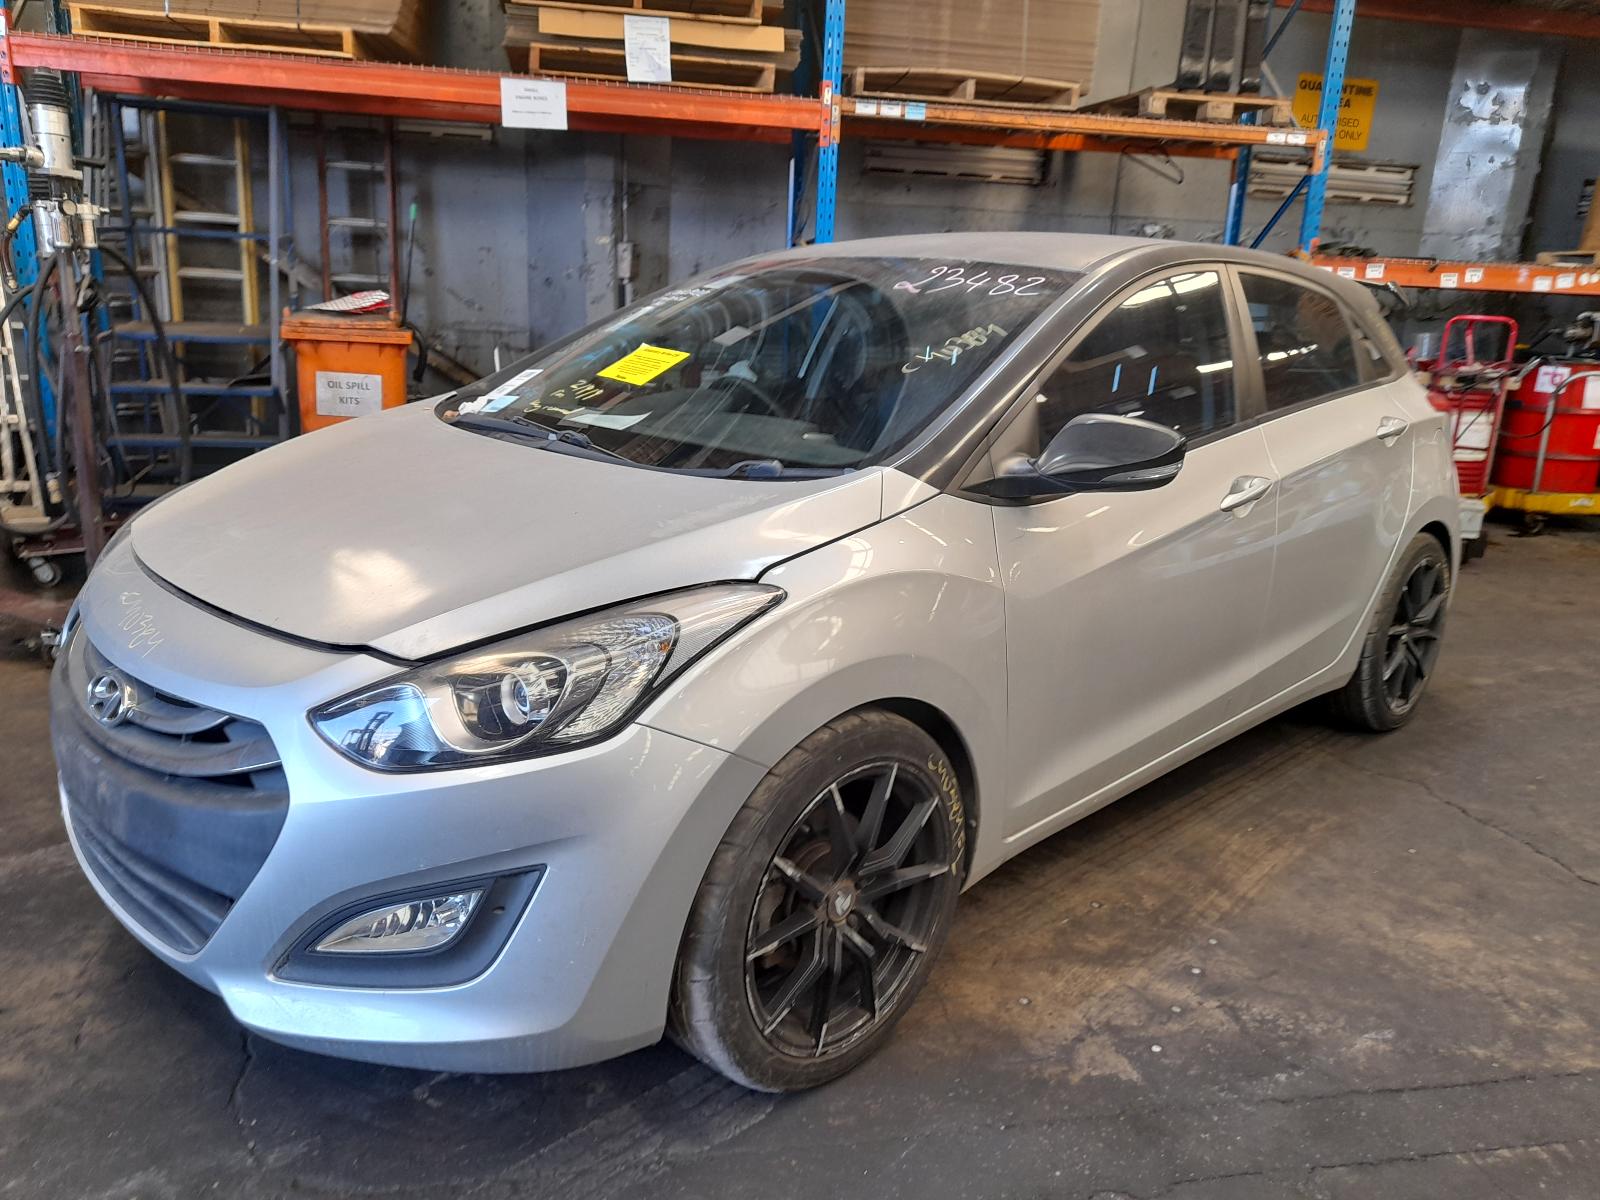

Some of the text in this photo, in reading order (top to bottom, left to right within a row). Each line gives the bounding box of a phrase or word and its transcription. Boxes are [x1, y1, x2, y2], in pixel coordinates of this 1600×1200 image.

[1299, 79, 1374, 97] QUANTINE
[1339, 129, 1362, 141] ONLY
[892, 266, 1046, 296] 23482
[327, 380, 371, 391] OIL SPILL
[338, 396, 360, 405] KITS
